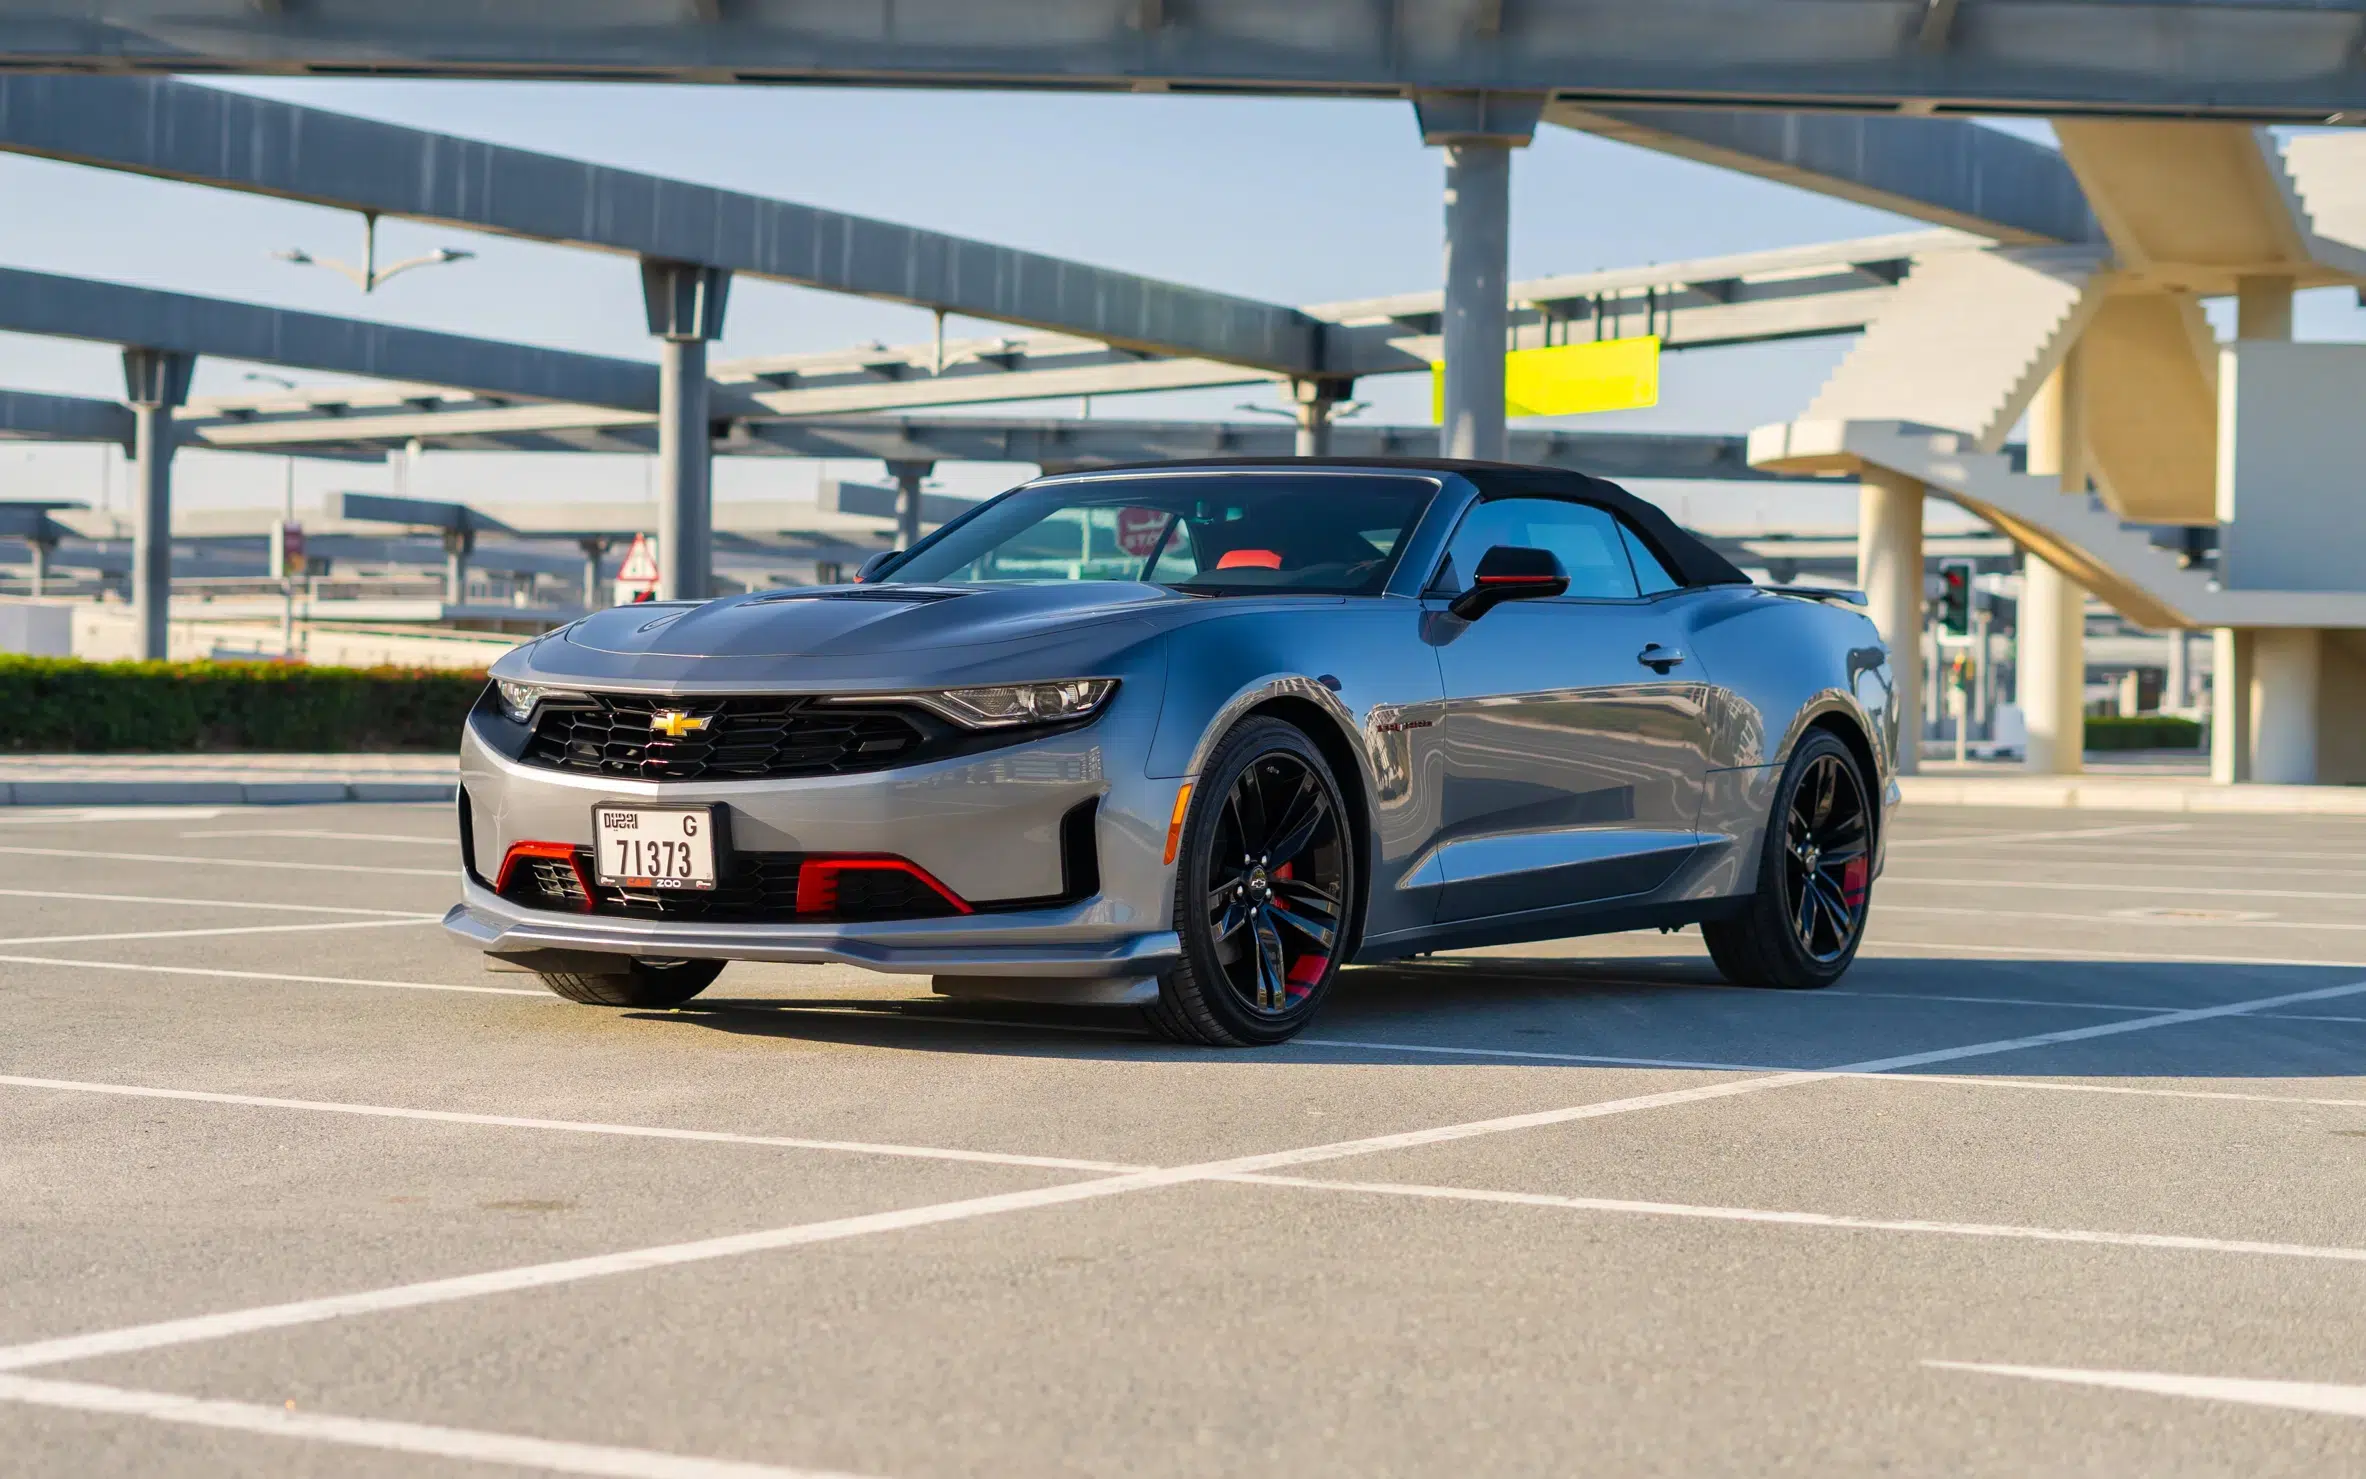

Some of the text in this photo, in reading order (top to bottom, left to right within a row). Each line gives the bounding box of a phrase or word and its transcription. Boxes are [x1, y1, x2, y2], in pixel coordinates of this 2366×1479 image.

[683, 815, 697, 837] G
[616, 840, 692, 877] 71373
[656, 879, 682, 888] ZOO
